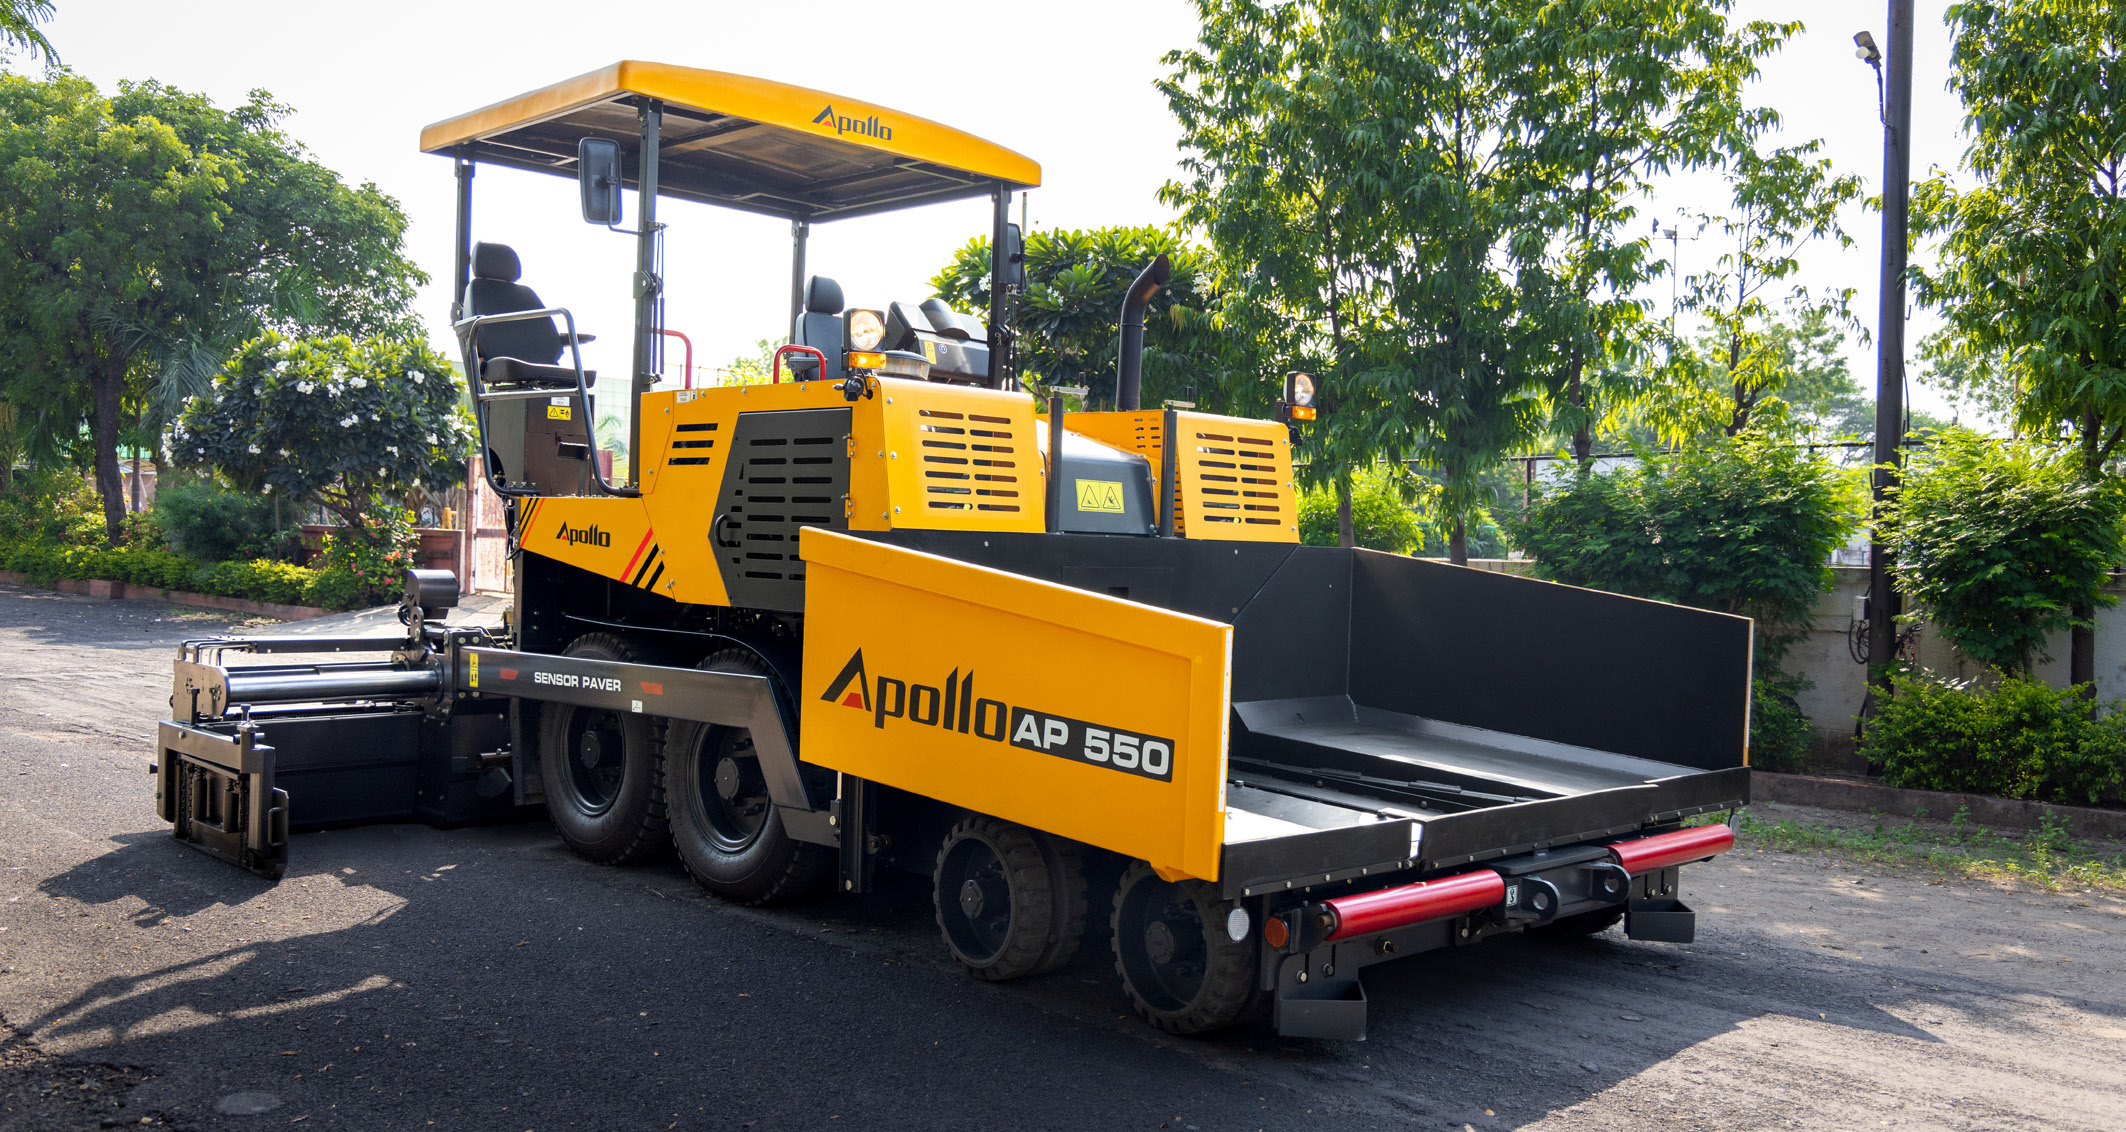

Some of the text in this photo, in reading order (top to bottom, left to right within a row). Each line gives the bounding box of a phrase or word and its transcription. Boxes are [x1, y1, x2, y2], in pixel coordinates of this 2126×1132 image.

[811, 104, 892, 141] Apollo
[556, 521, 610, 547] Apollo
[534, 671, 621, 691] SENSOR PAVER
[820, 647, 1170, 776] Apollo AP 550
